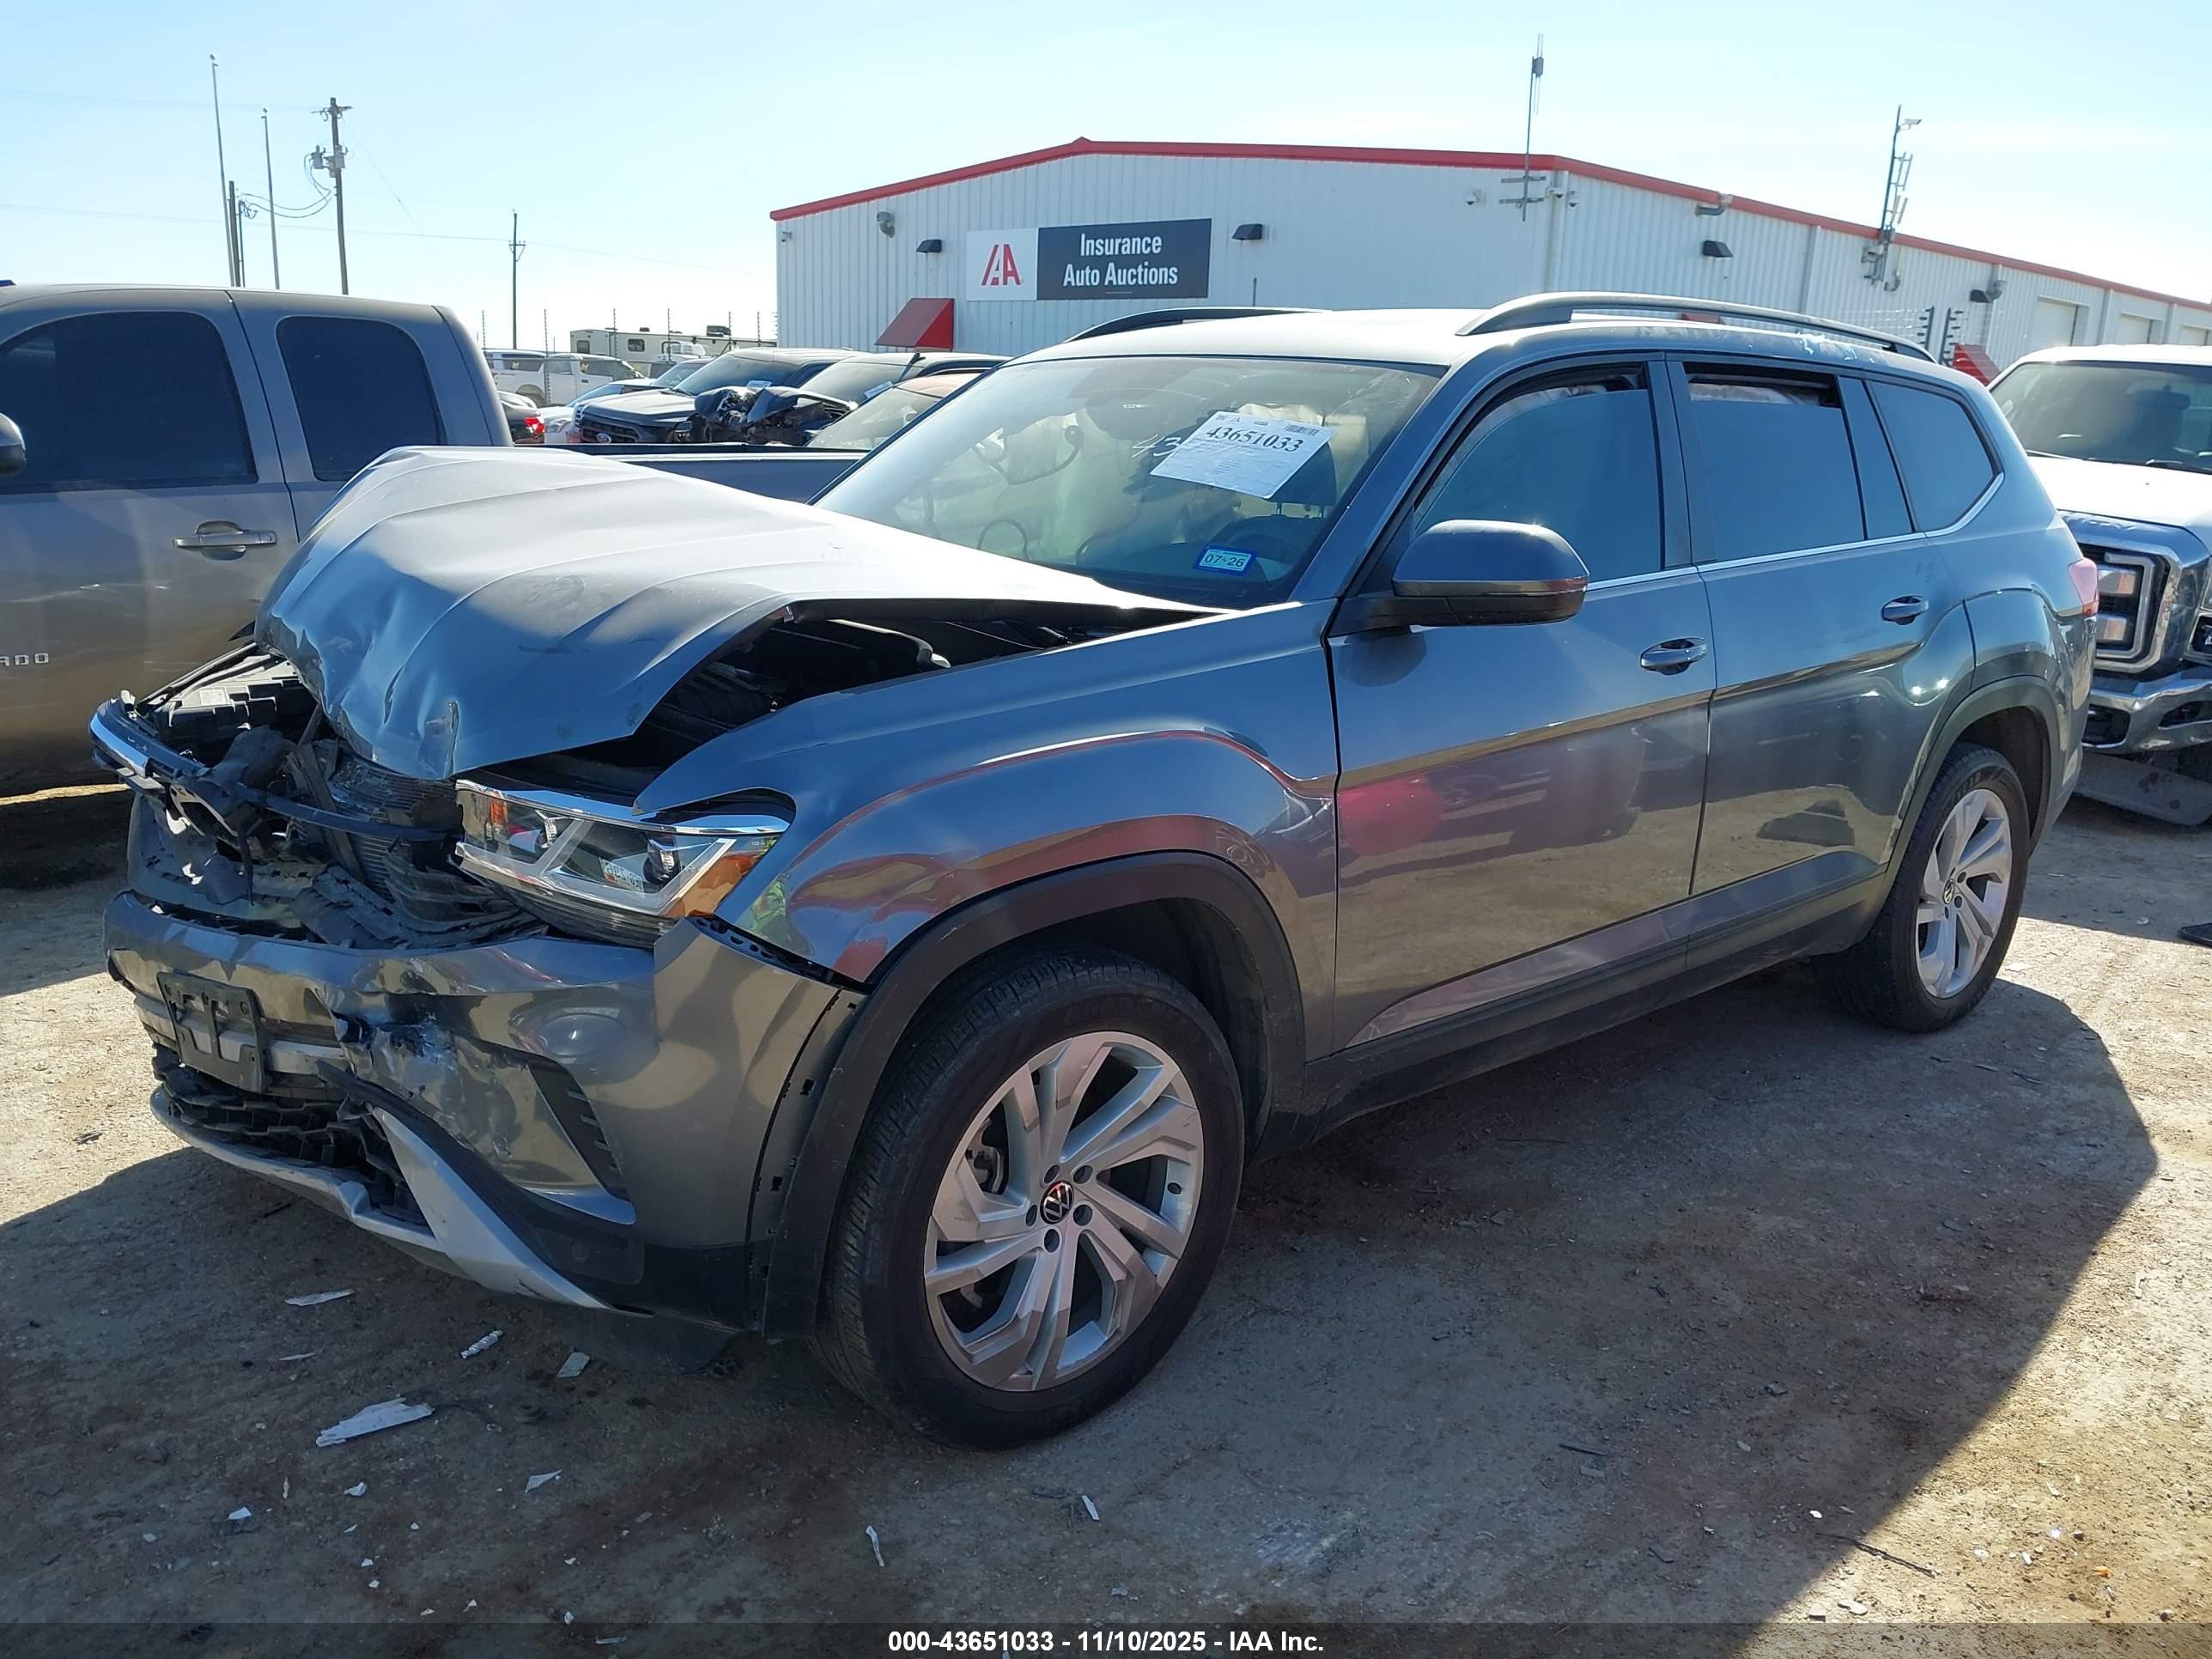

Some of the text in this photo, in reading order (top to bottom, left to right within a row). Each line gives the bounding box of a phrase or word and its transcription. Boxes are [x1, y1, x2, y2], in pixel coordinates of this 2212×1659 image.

[1080, 233, 1162, 256] Insurance
[1063, 261, 1178, 287] Auto Auctions
[1206, 425, 1304, 453] 43651033
